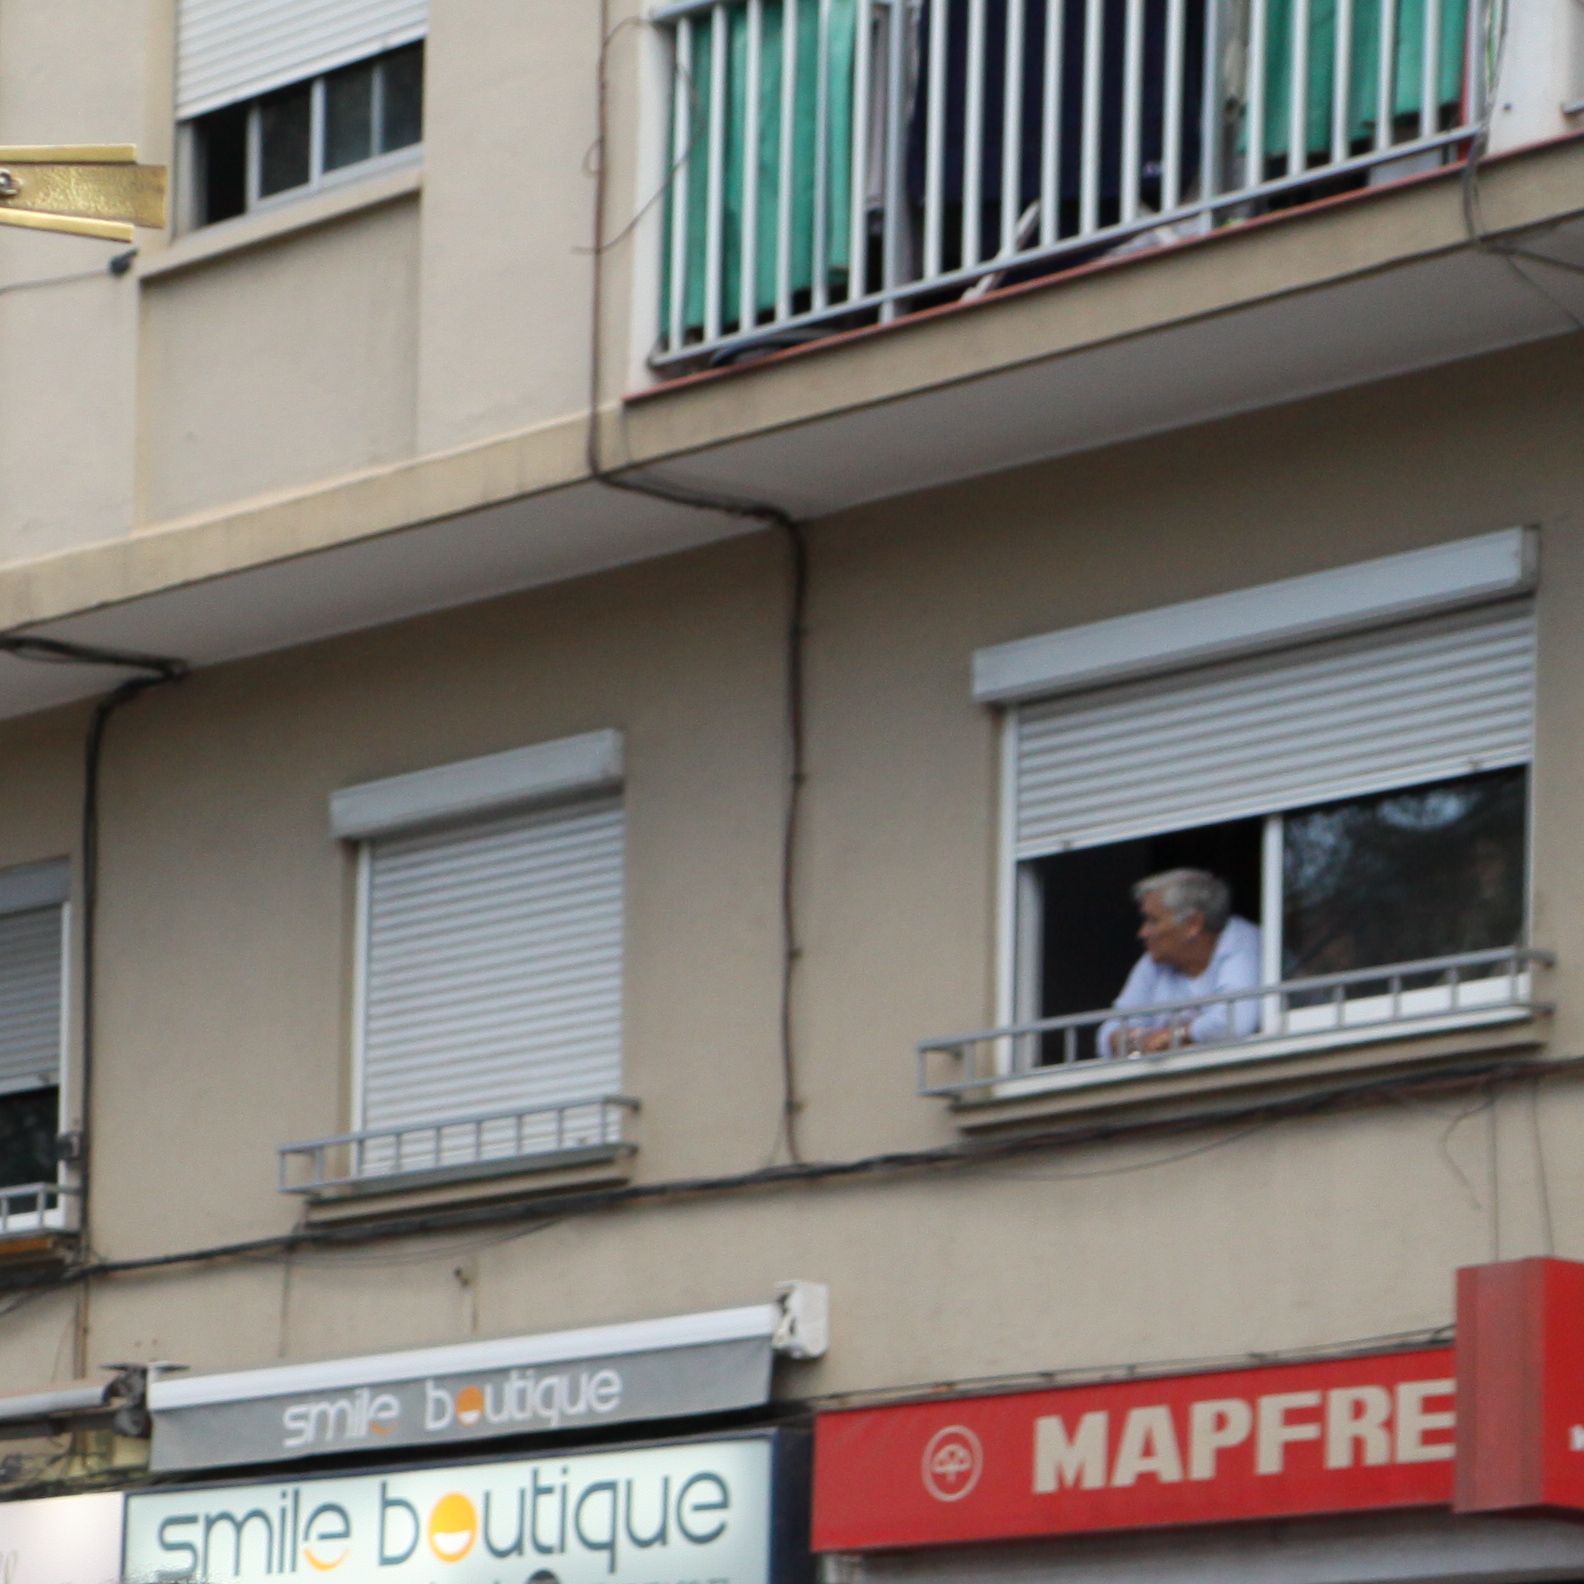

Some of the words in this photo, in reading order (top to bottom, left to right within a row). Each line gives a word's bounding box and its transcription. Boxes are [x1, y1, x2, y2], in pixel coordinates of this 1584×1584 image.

[282, 1385, 400, 1449] smile
[425, 1368, 623, 1432] boutique
[1033, 1377, 1457, 1495] MAPFRE
[157, 1489, 353, 1582] smile
[378, 1467, 730, 1575] boutique
